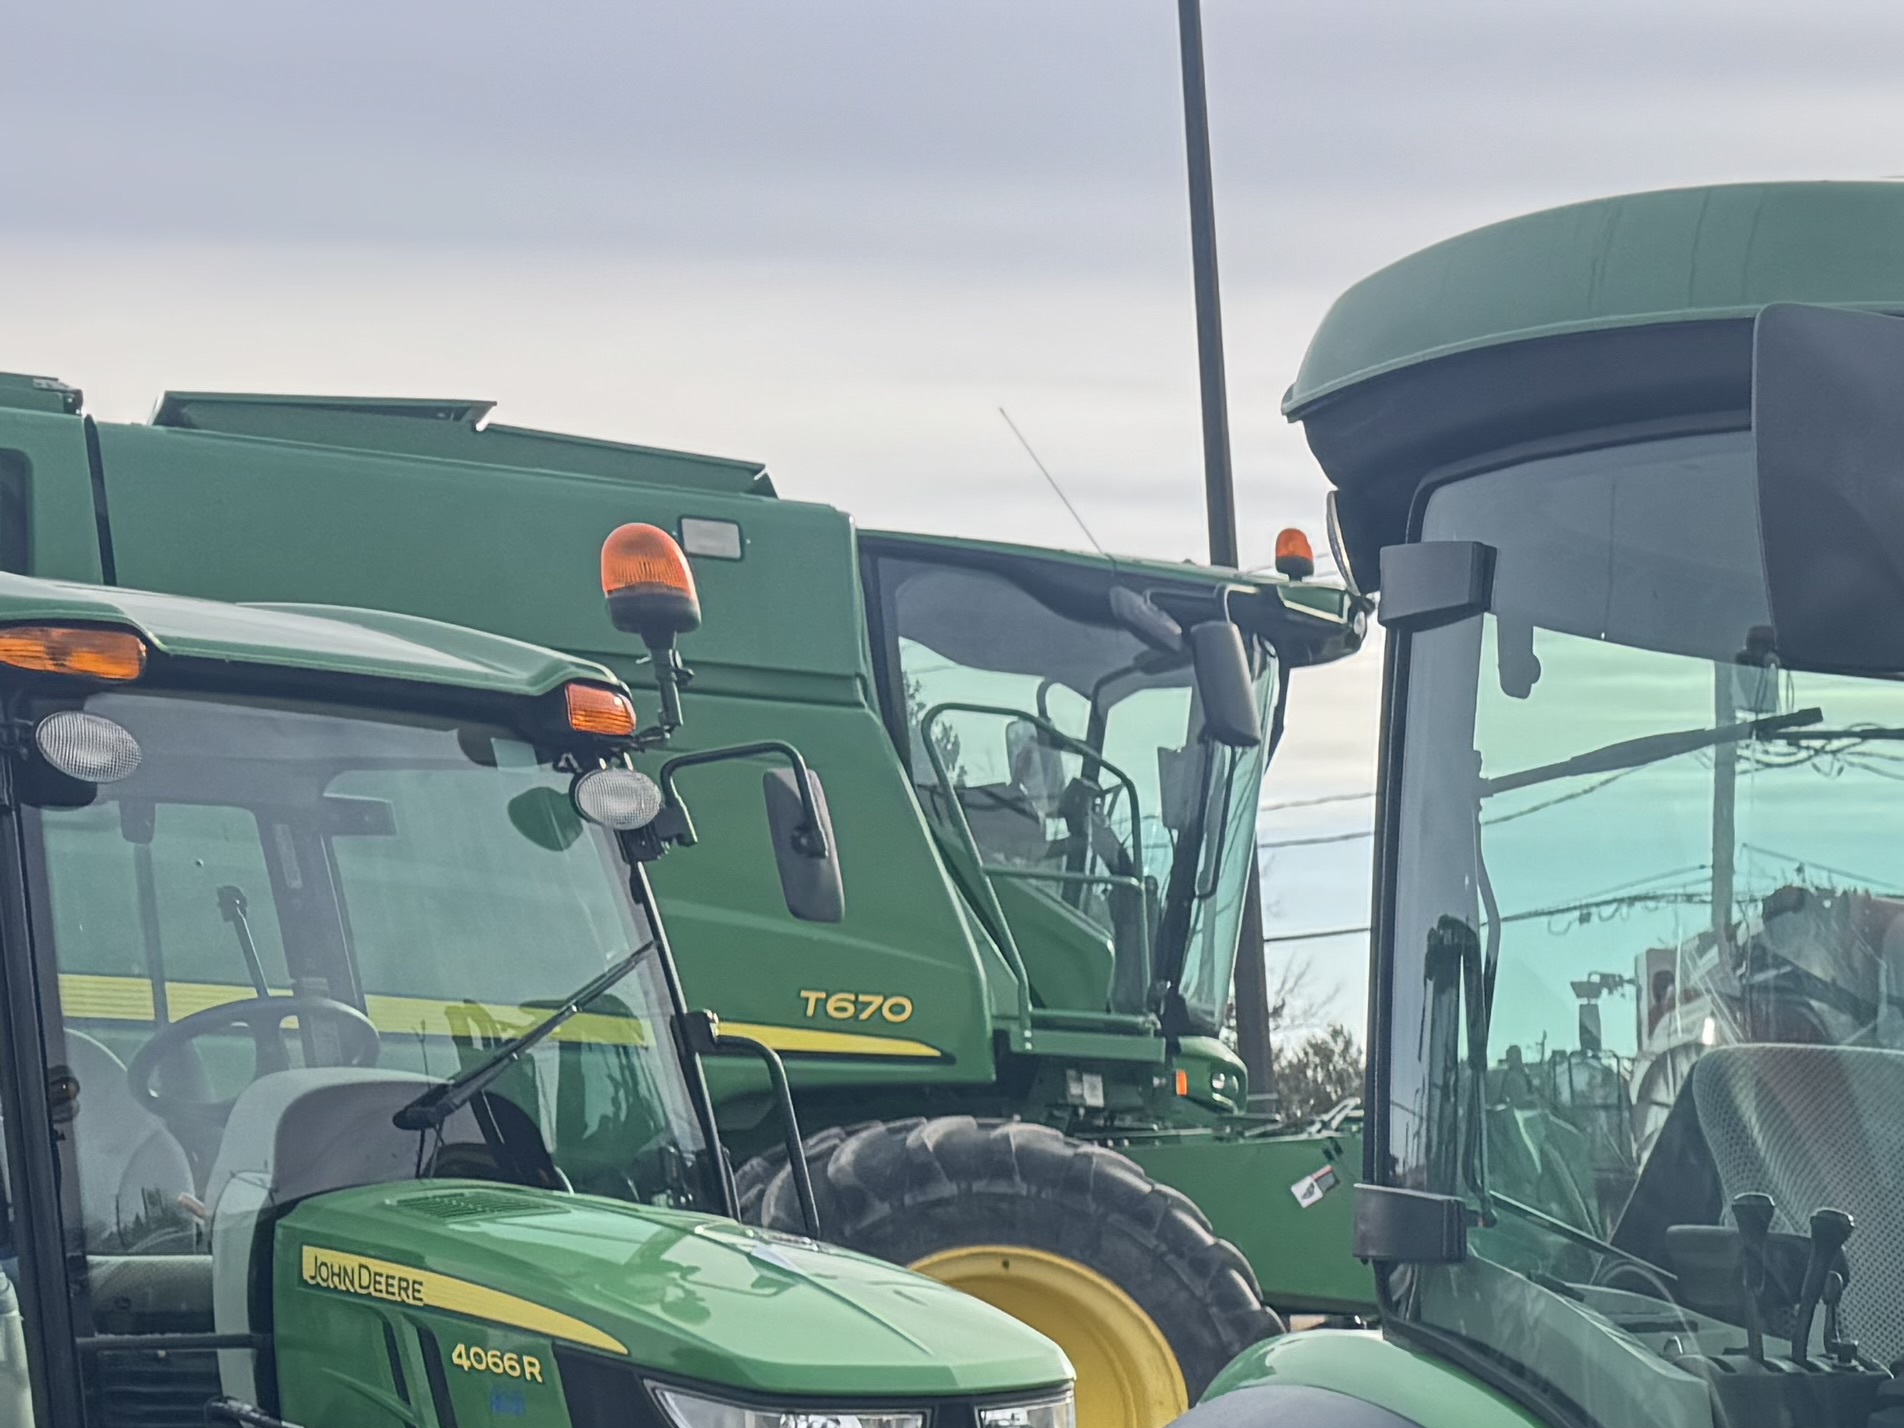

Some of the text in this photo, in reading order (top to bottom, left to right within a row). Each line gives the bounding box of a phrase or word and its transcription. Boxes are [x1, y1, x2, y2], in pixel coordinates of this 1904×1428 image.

[799, 989, 913, 1023] T670
[309, 1254, 424, 1303] JOHN DEERE
